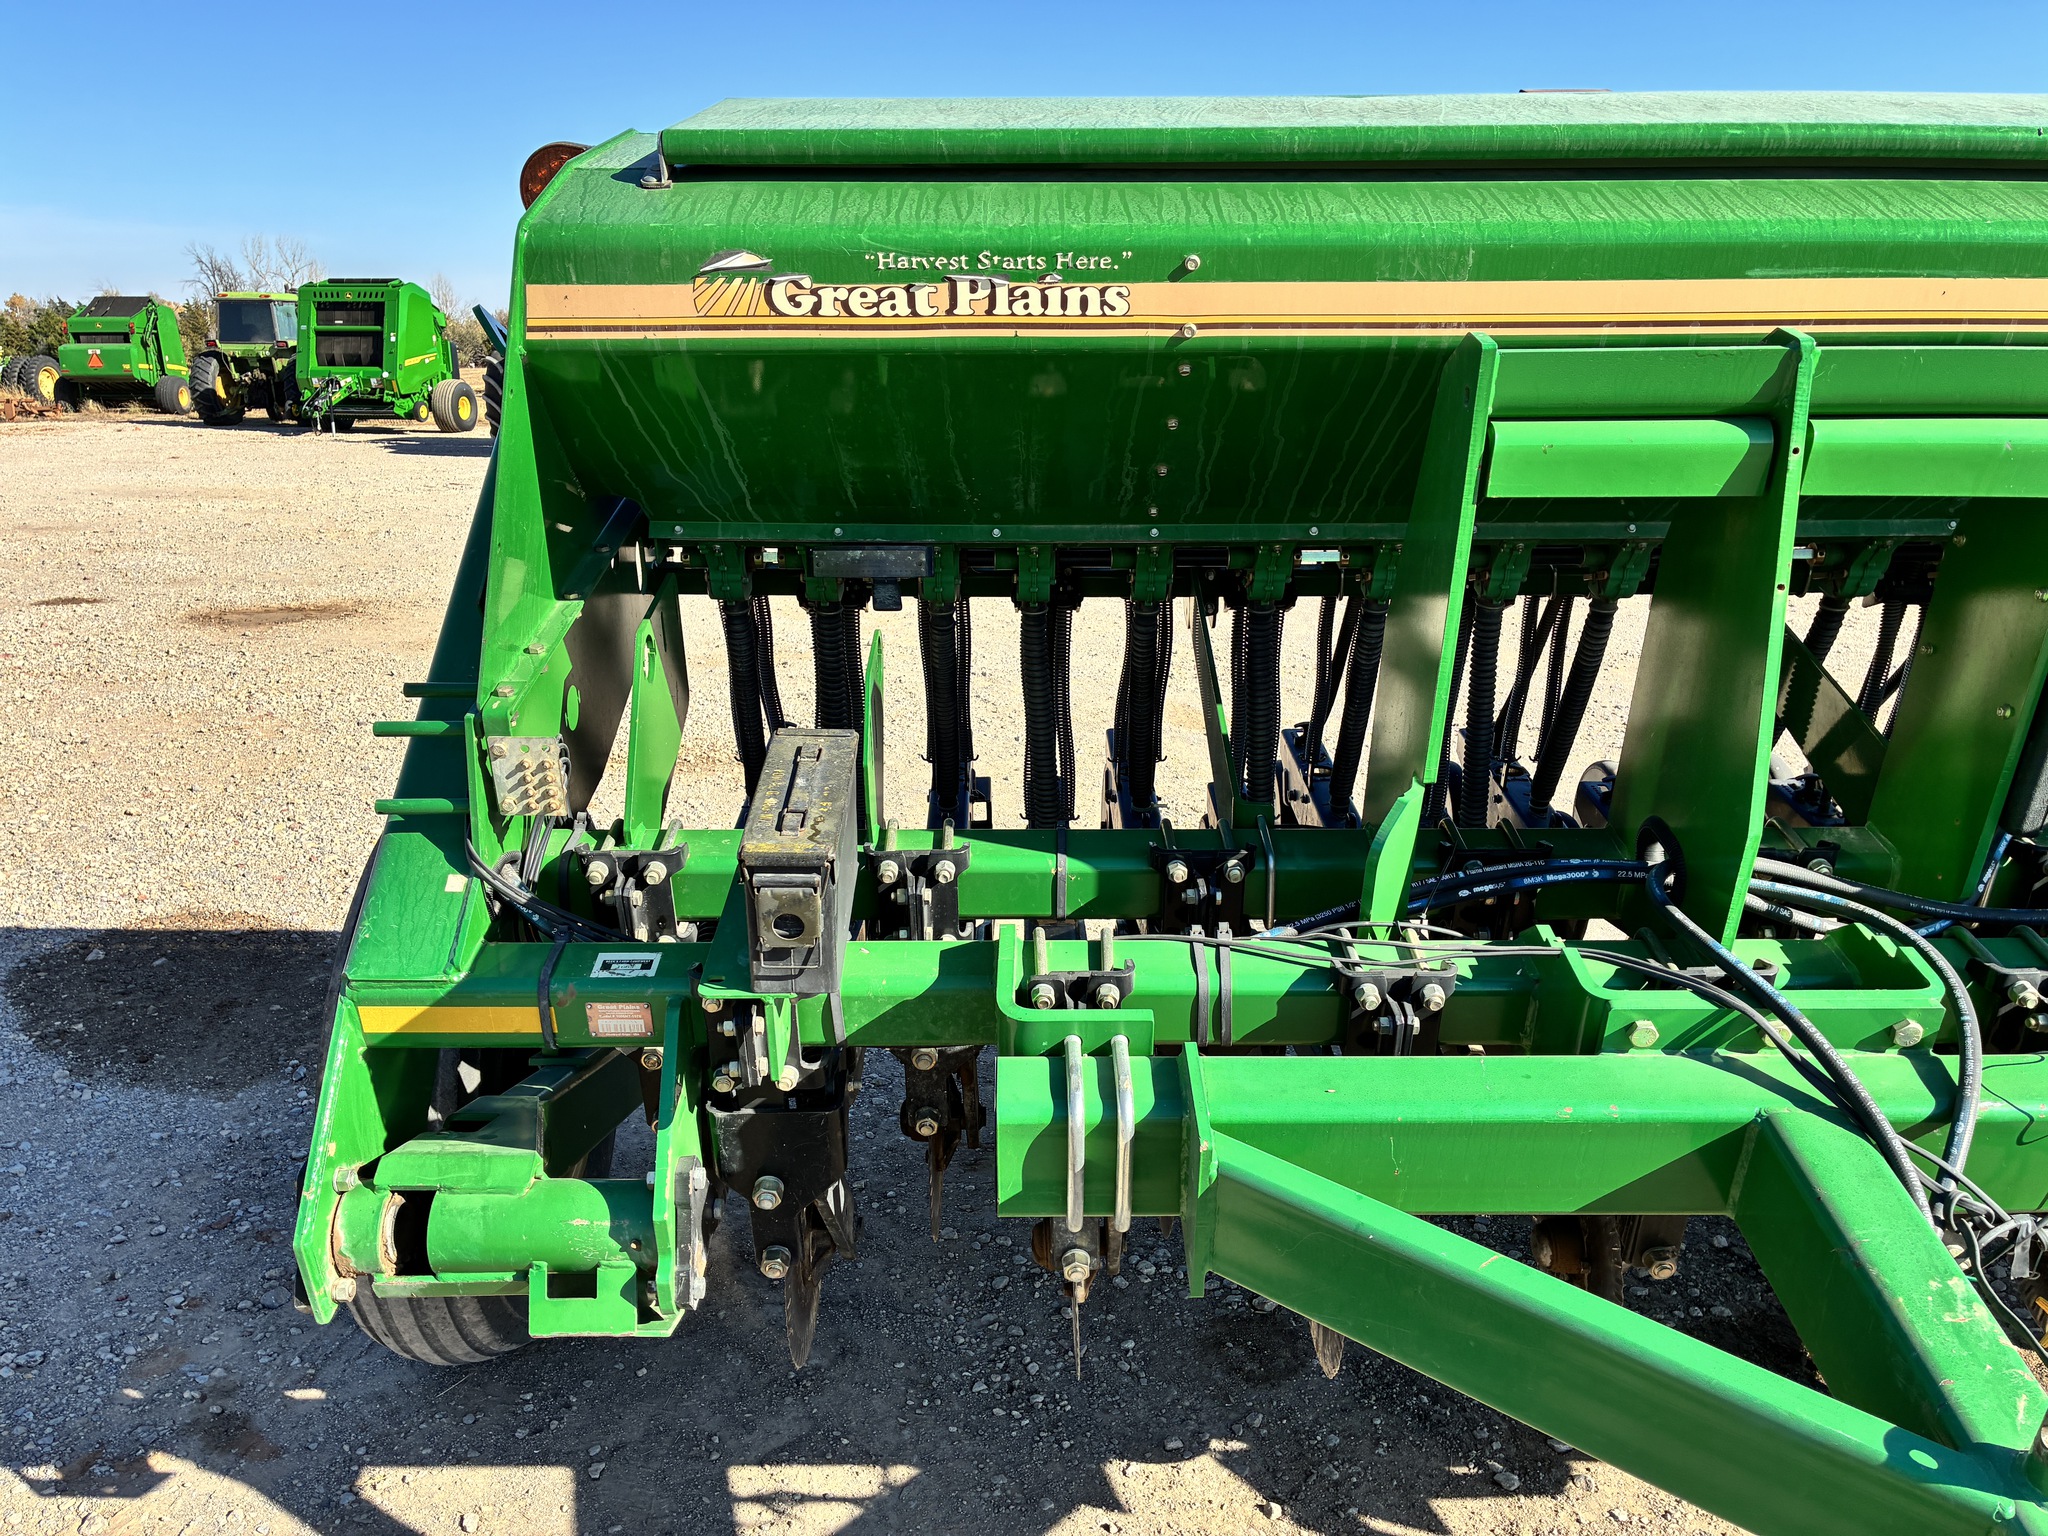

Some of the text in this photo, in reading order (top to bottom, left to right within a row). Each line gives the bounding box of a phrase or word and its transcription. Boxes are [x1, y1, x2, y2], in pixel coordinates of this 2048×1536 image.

[977, 250, 1046, 270] Starts
[767, 274, 1131, 317] Great Plains
[1523, 875, 1544, 885] 8M3K
[1617, 870, 1634, 878] 22.5
[1299, 915, 1316, 925] MPa
[1314, 909, 1333, 921] (3250
[1779, 908, 1791, 918] SAE
[1800, 1017, 1816, 1033] 22.5
[1814, 1032, 1831, 1049] MPa
[1827, 1049, 1847, 1068] (3250
[1844, 1068, 1860, 1084] PSI)
[1867, 1101, 1886, 1120] (12.5
[1881, 1120, 1896, 1137] mm)
[1916, 1190, 1929, 1207] SAE
